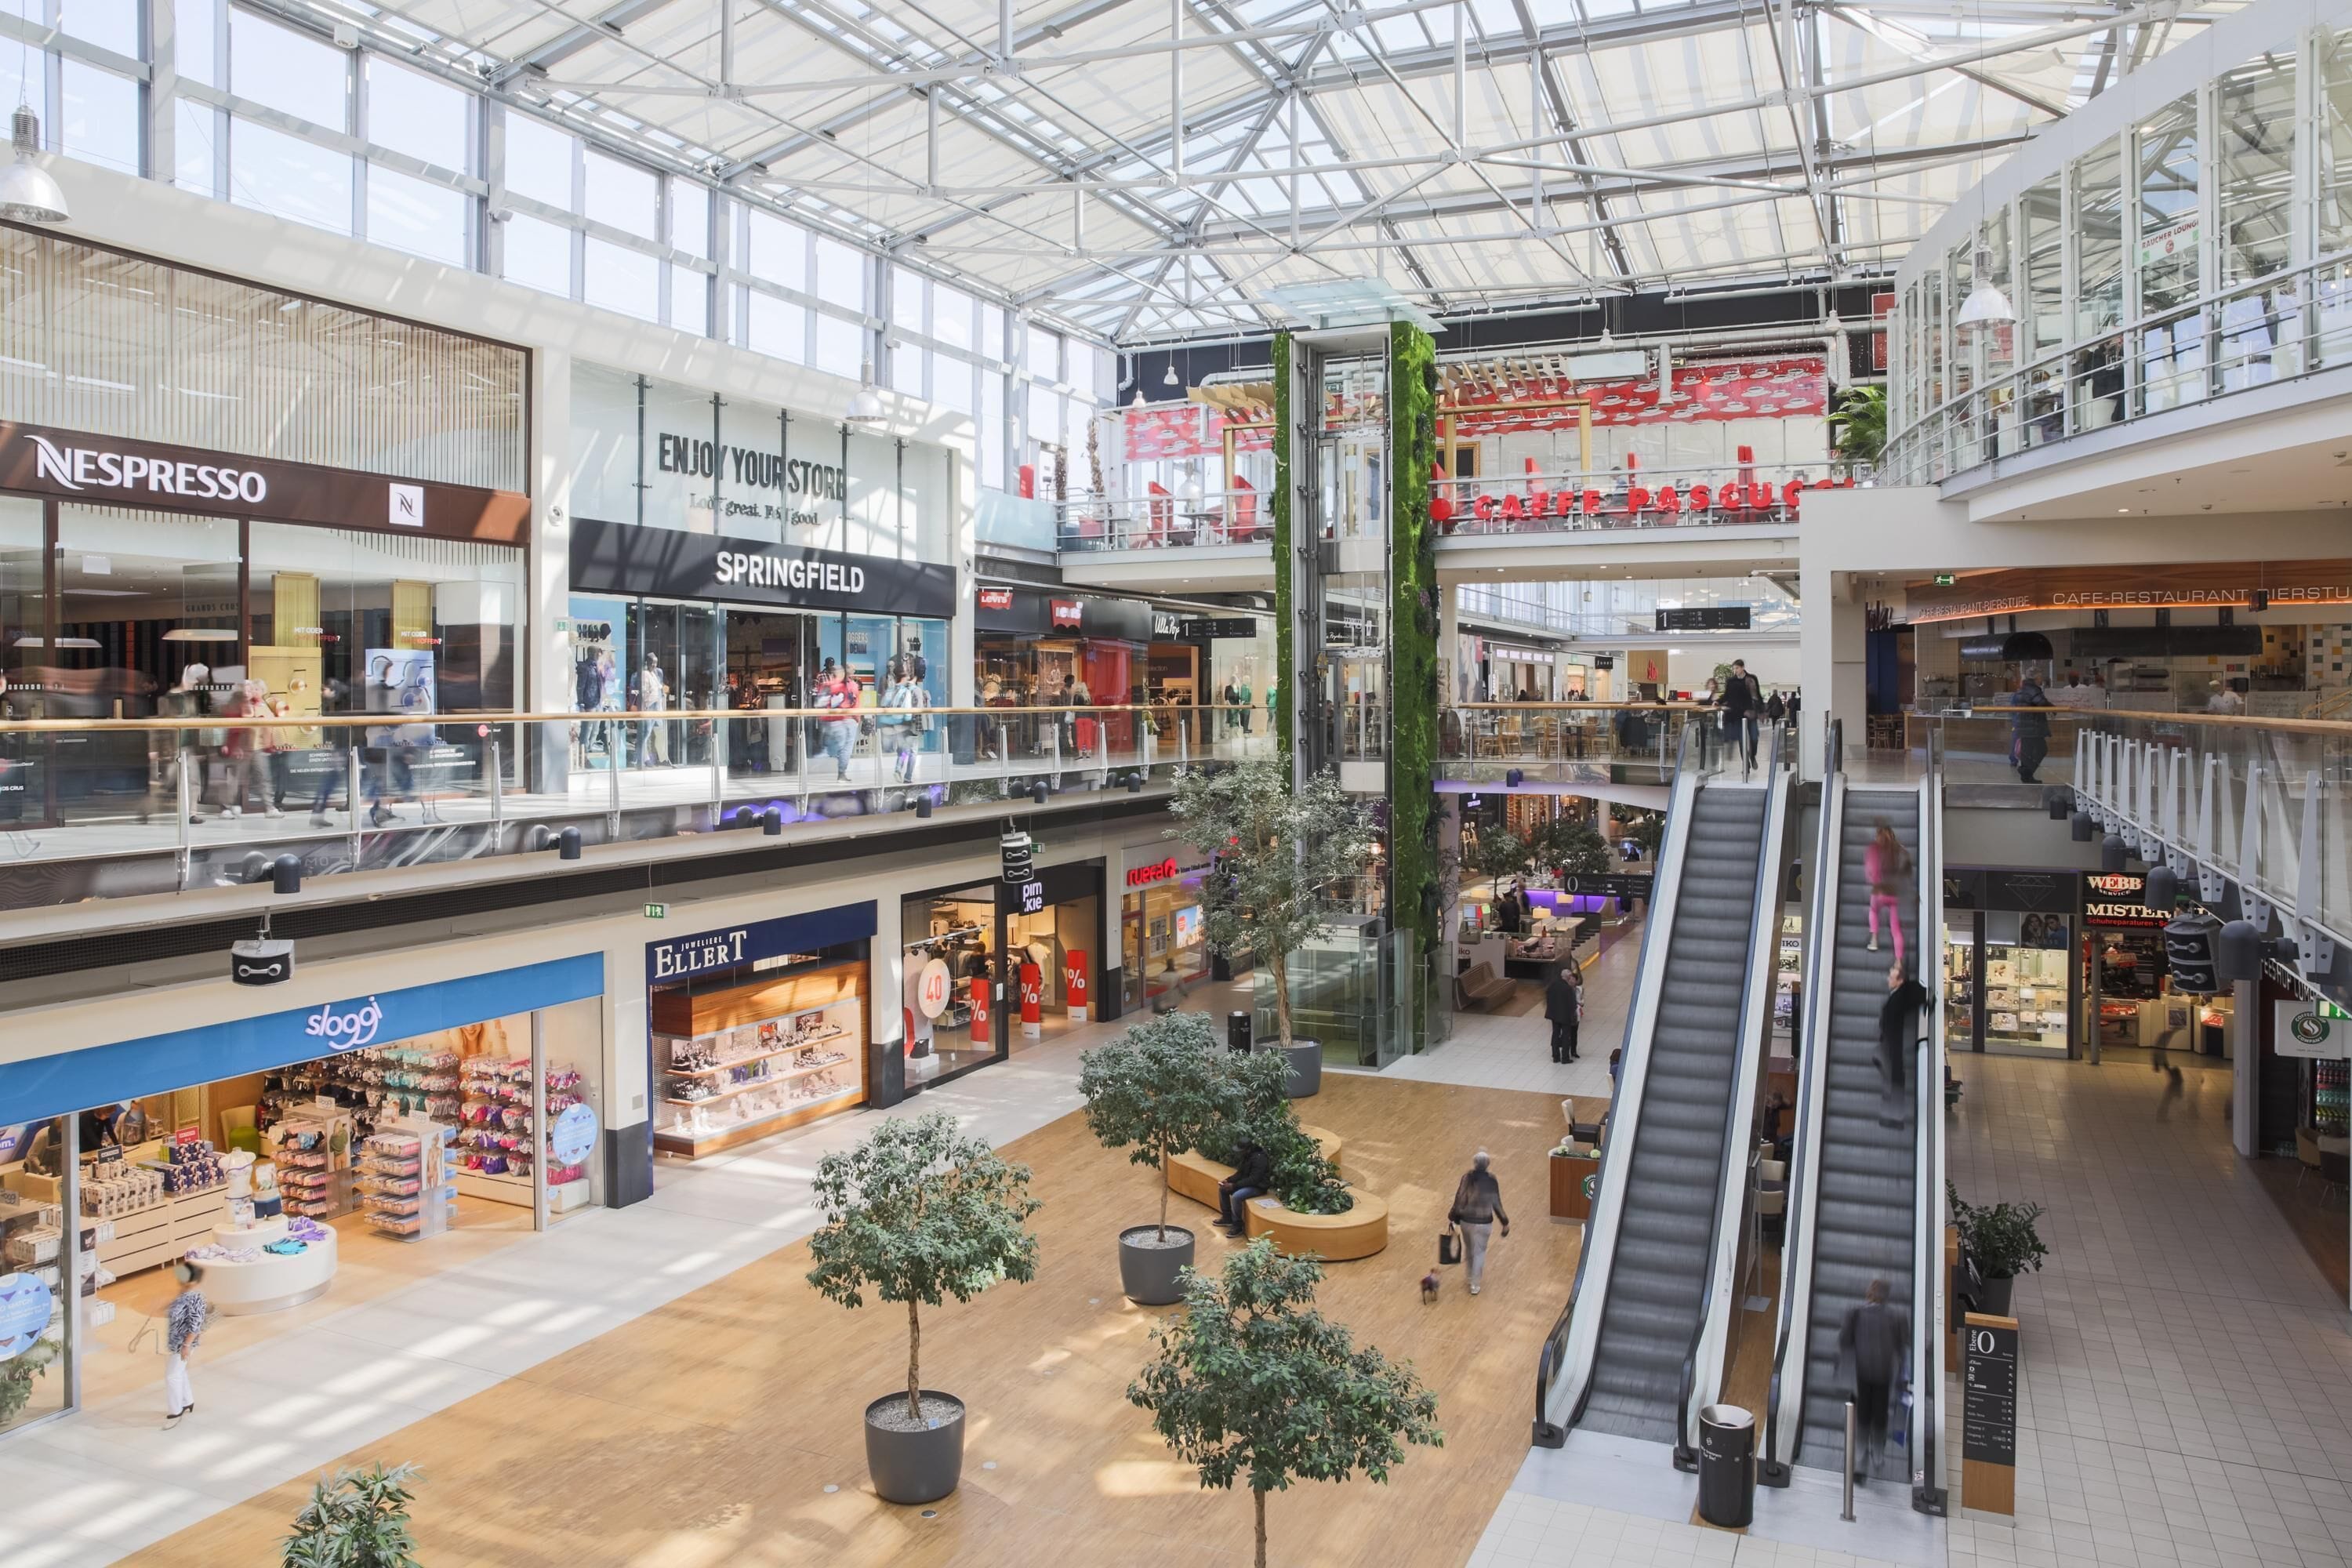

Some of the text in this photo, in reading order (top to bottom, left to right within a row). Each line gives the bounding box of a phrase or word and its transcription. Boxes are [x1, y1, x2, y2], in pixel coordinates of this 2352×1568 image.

[2142, 219, 2199, 249] RAUCHER LOUNG
[23, 435, 267, 503] NESPRESSO
[659, 433, 728, 480] ENJOY
[732, 447, 783, 492] YOUR
[1628, 477, 1854, 514] PASCUC
[717, 551, 865, 593] SPRINGFIELD
[2053, 588, 2249, 605] CAFE-RESTAURANT
[1182, 622, 1189, 637] 1
[1659, 612, 1667, 628] 1
[848, 632, 869, 643] OGGERS
[1022, 881, 1043, 902] pim
[2086, 876, 2143, 891] WEBB
[2098, 888, 2132, 897] SERVICE
[2087, 917, 2154, 927] Schuhreparaturen
[681, 935, 722, 952] JUWELIERE
[925, 975, 942, 1000] 40
[305, 996, 383, 1050] sloggi
[2297, 1035, 2323, 1044] COMPANY
[1969, 1329, 1995, 1354] Ebene 0
